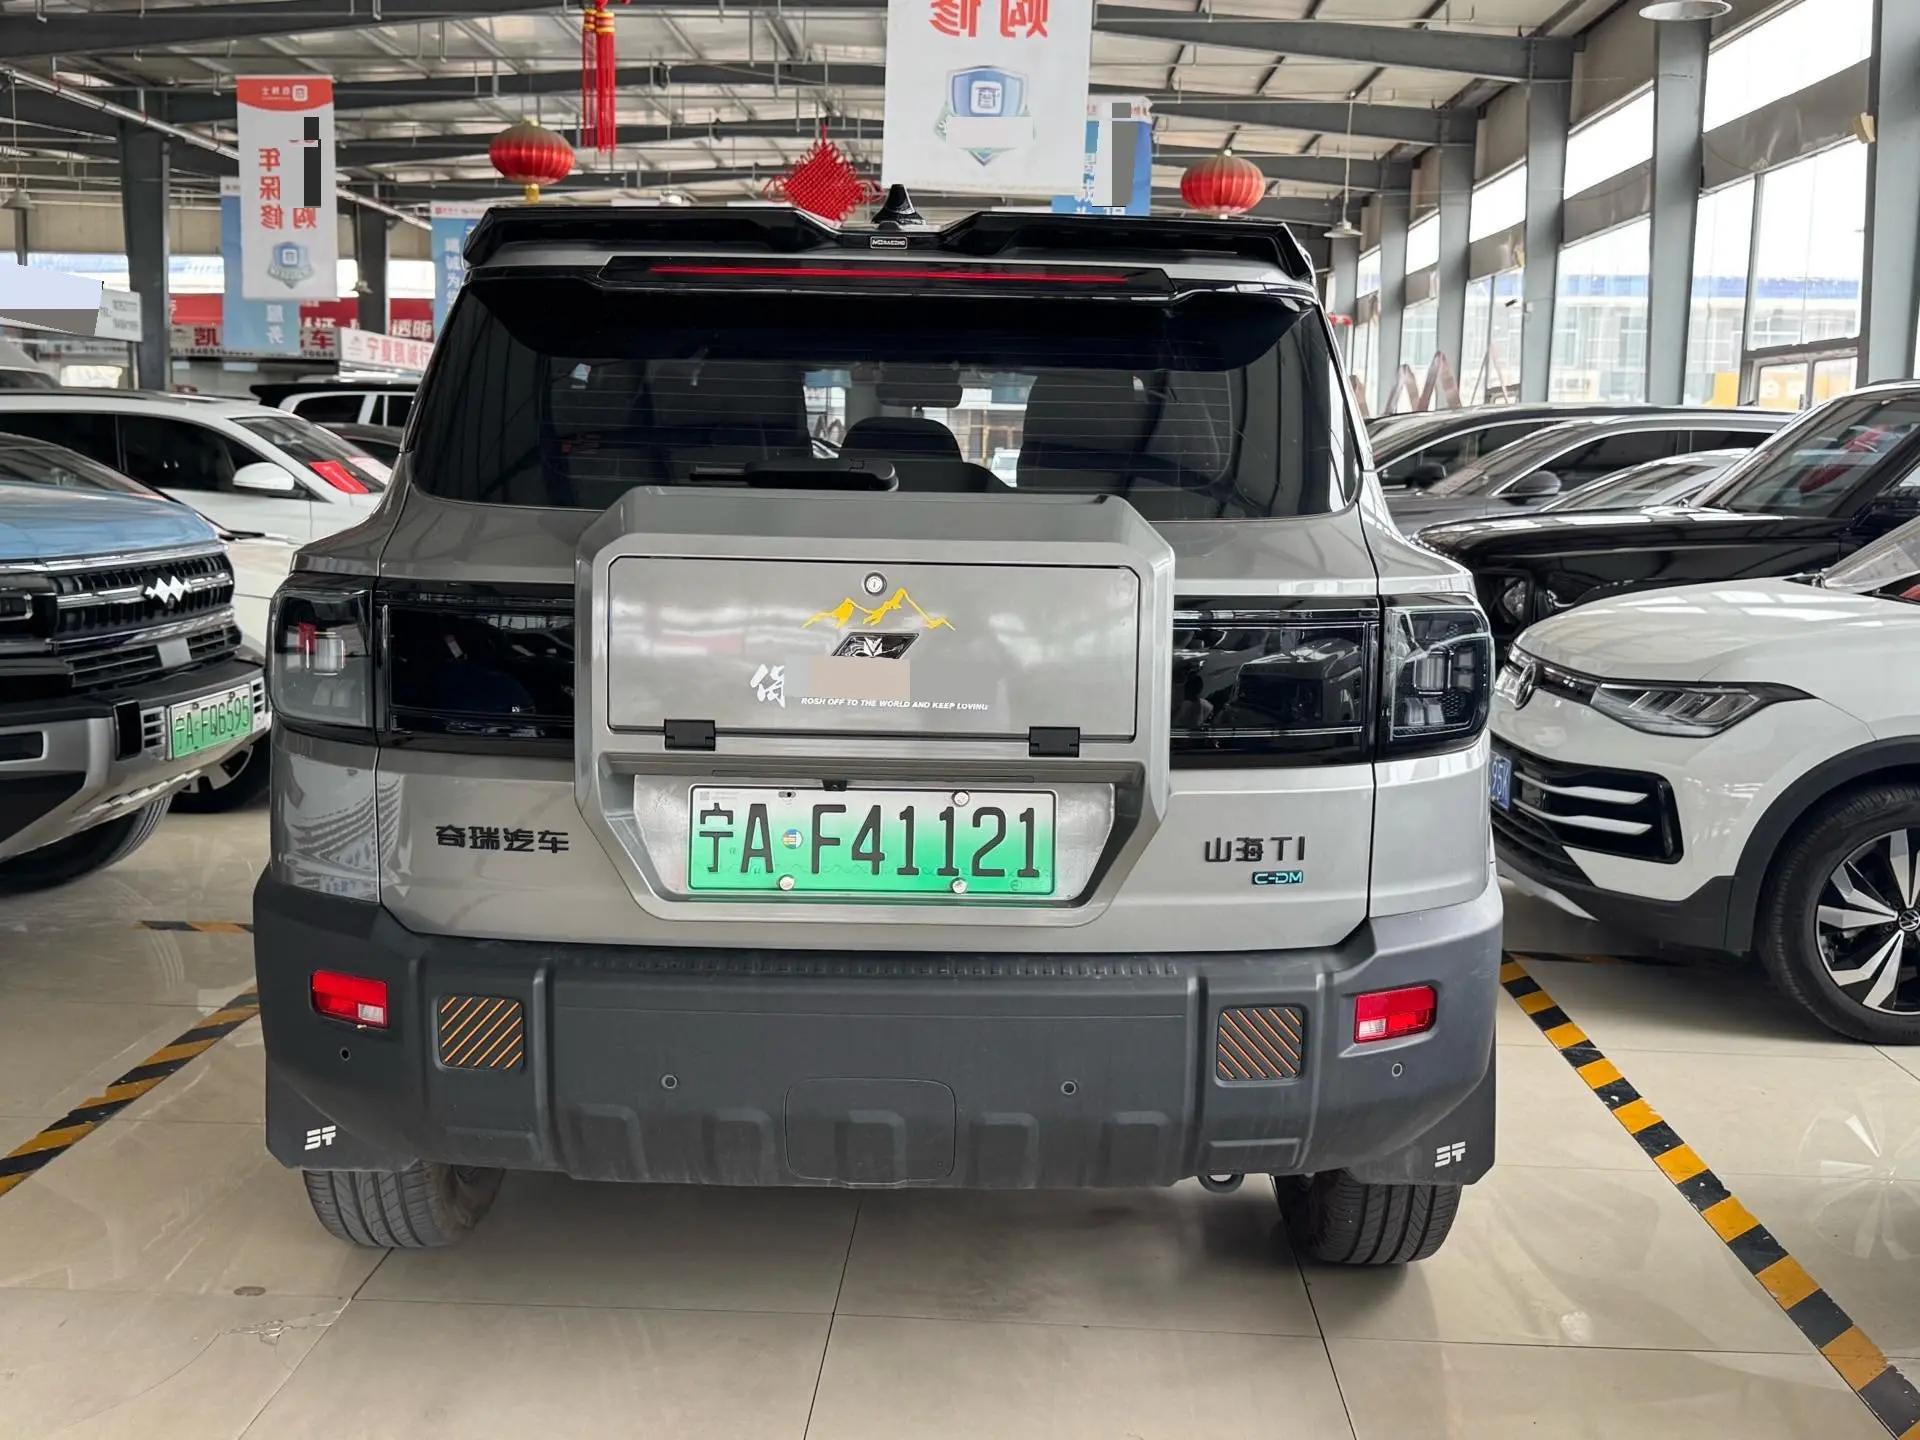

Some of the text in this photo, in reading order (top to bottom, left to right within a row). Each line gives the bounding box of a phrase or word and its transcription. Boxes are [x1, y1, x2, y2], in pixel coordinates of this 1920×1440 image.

[827, 698, 844, 706] OFF
[861, 699, 877, 707] THE
[879, 700, 910, 708] WORLD
[912, 701, 930, 709] AND
[435, 824, 569, 854] 奇瑞汽车
[1254, 871, 1303, 885] C-DM
